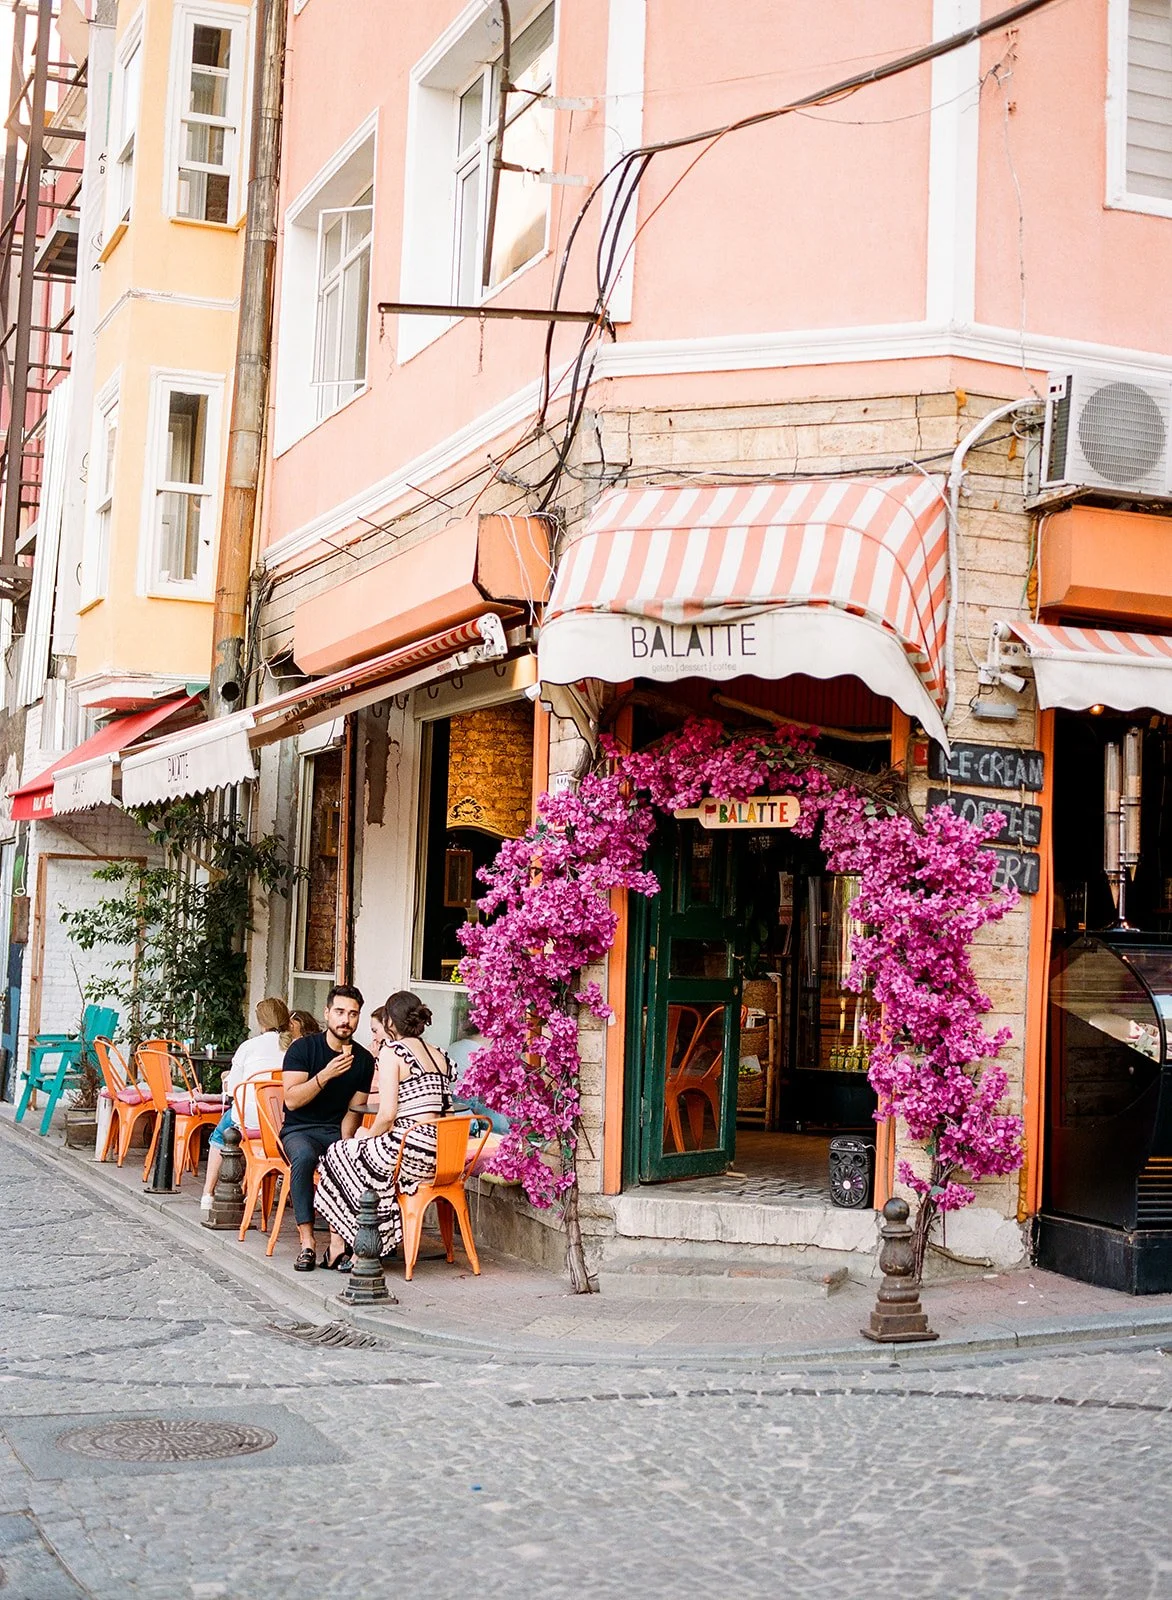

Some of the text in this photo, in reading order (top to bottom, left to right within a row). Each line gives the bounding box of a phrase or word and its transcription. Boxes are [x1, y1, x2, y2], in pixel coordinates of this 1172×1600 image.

[632, 623, 756, 658] BALATTE
[652, 662, 737, 673] gelato dessert coffee
[719, 802, 789, 823] BALATTE
